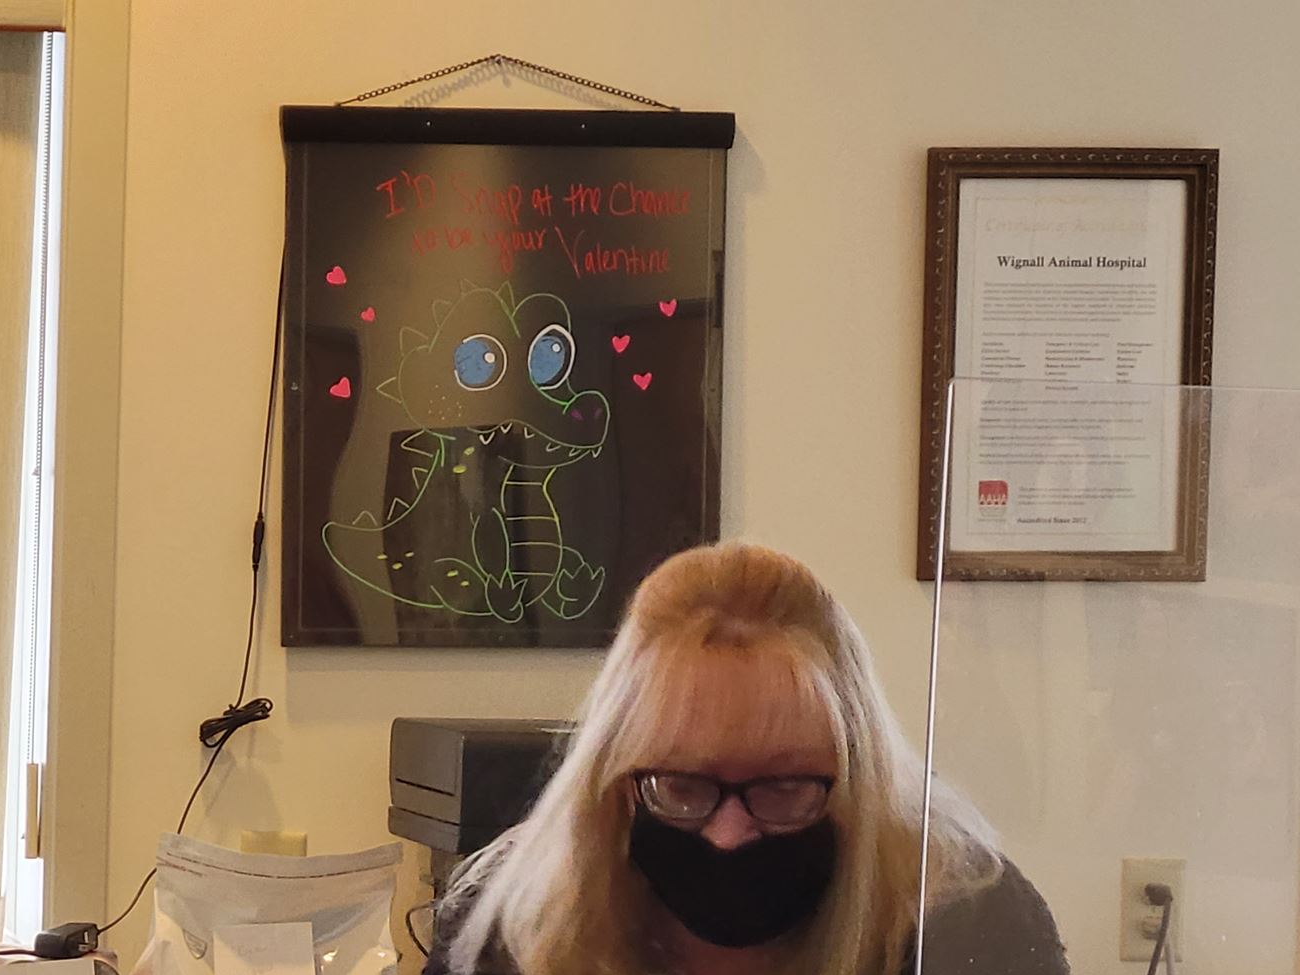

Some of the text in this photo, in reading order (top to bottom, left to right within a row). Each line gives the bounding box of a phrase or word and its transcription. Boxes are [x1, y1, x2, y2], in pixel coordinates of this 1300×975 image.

[531, 184, 552, 216] at
[564, 184, 601, 217] the
[554, 226, 669, 279] Valentine
[997, 255, 1147, 271] Wignall Animal Hospital
